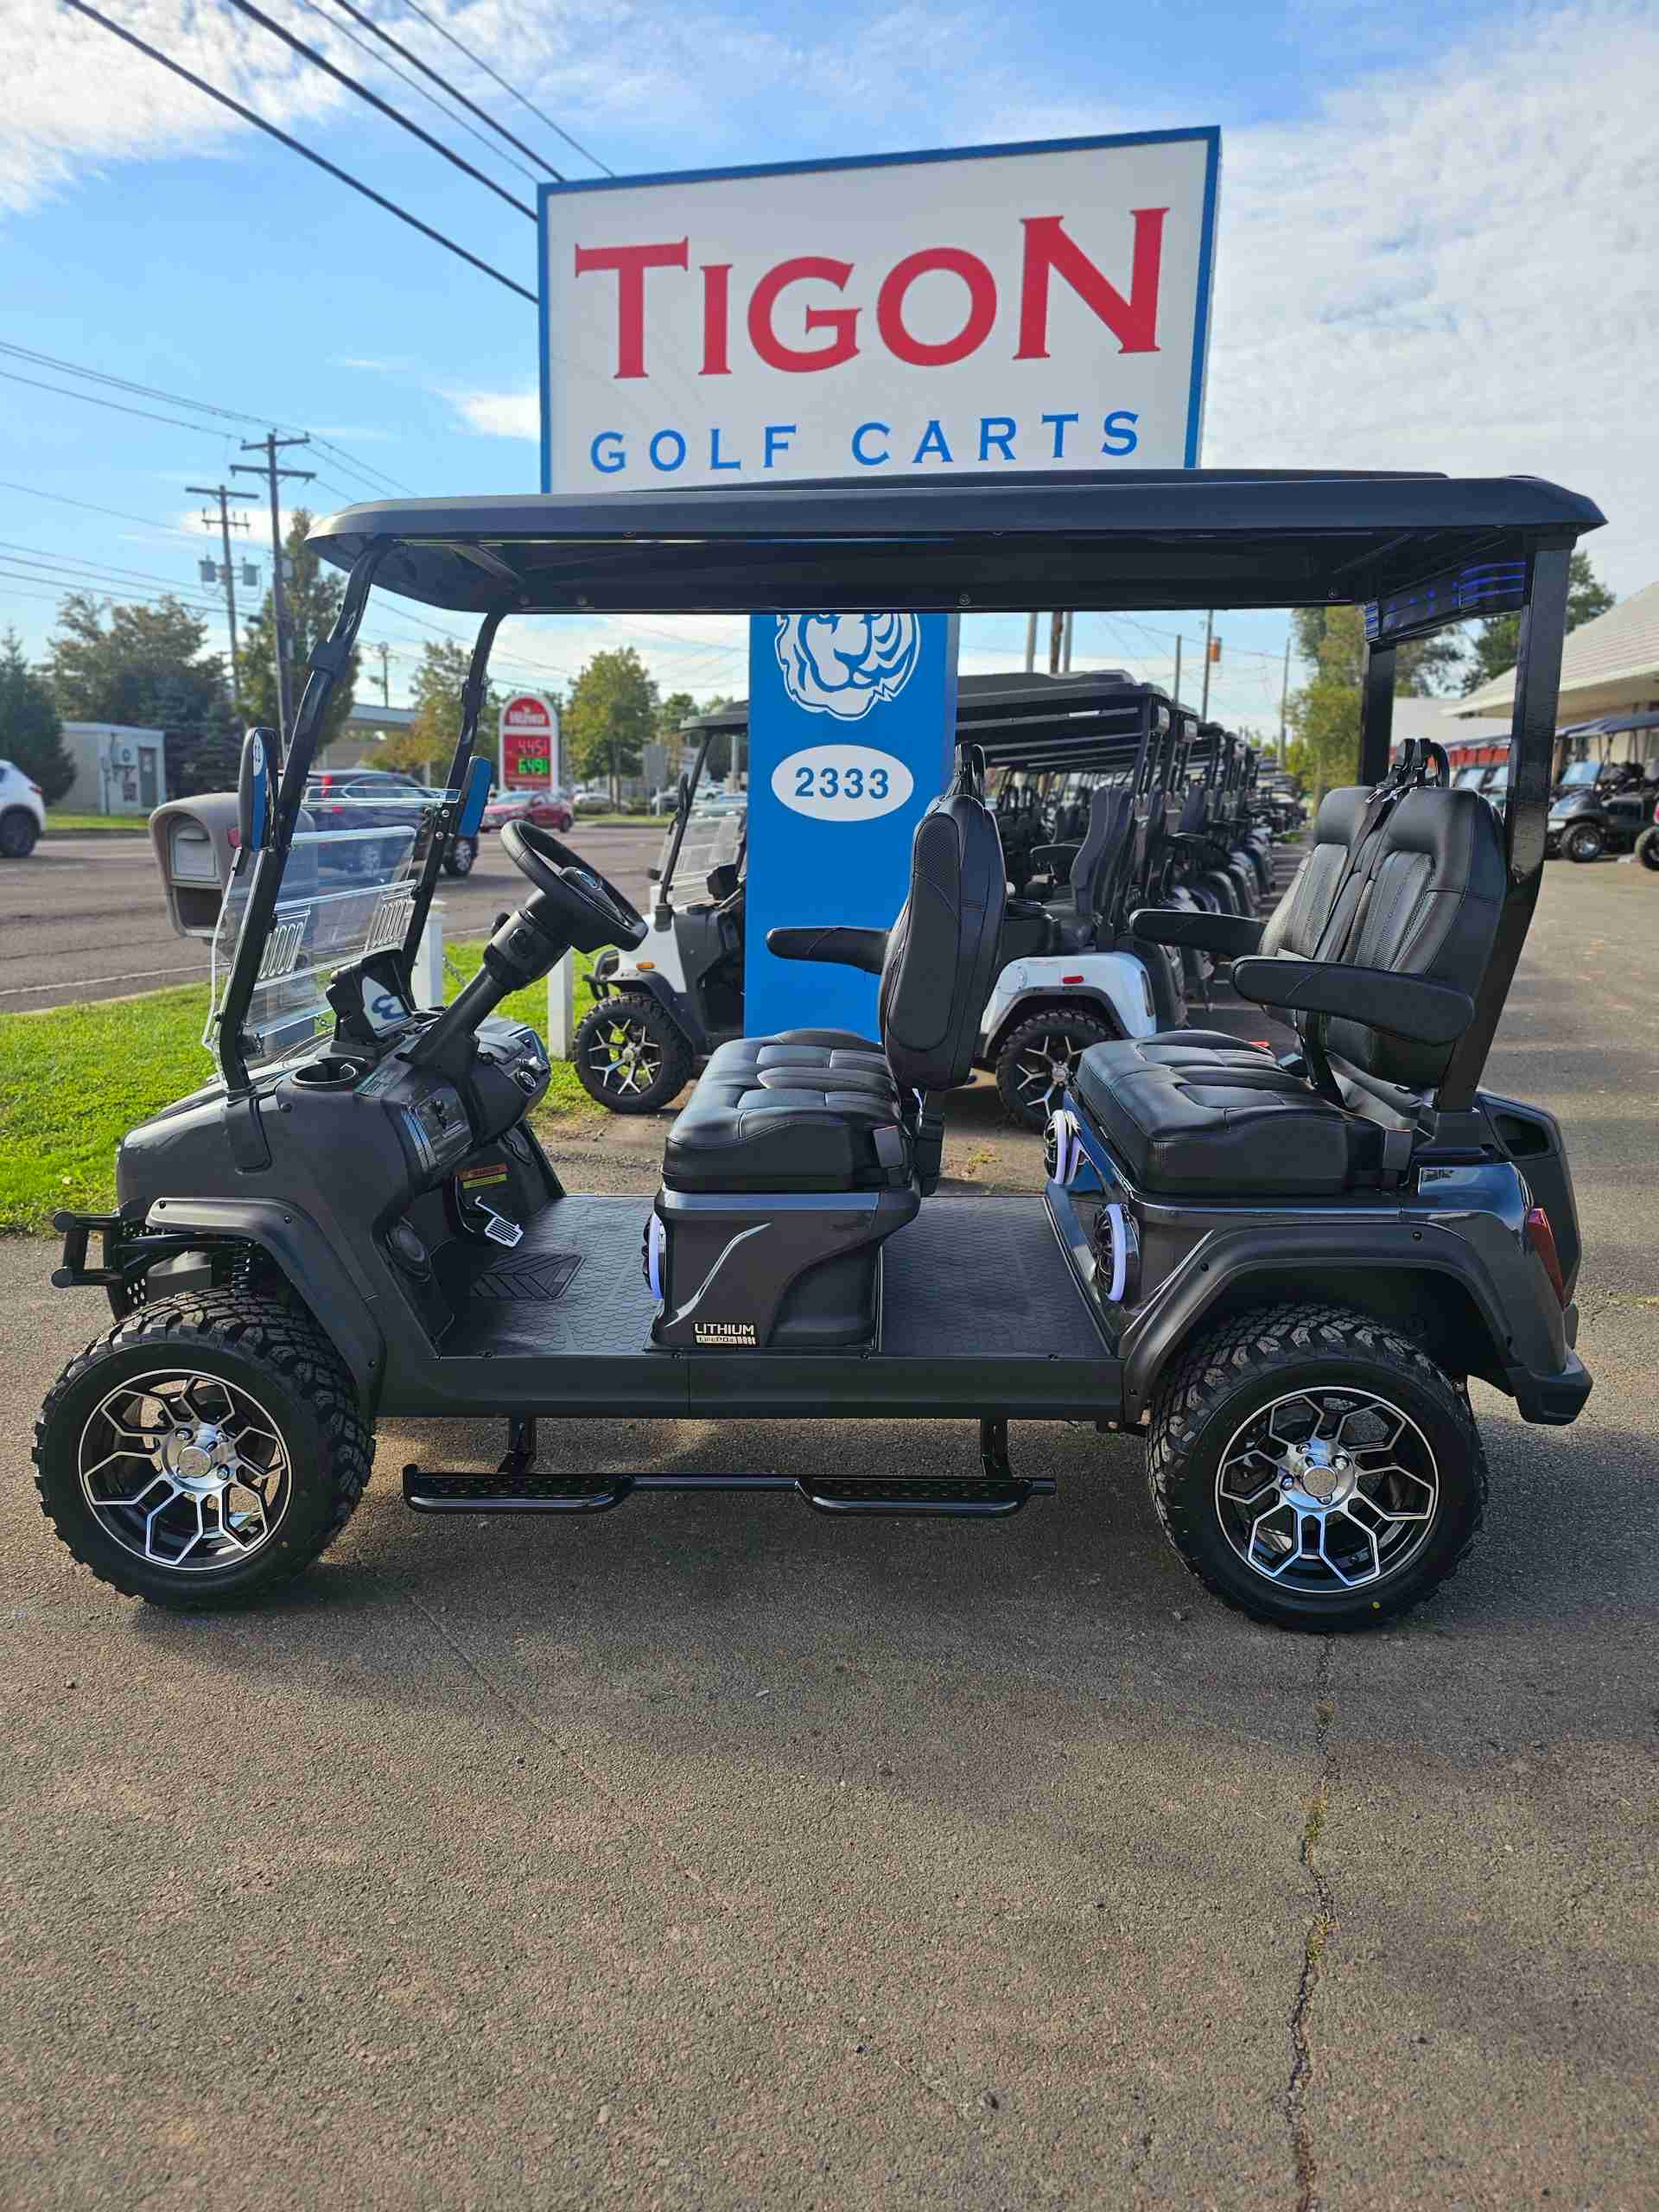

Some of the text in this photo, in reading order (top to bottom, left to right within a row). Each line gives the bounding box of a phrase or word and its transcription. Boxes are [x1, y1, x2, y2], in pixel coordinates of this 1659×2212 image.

[575, 207, 1170, 378] TIGON
[590, 410, 1139, 474] GOLF CARTS
[795, 766, 888, 799] 2333
[694, 1323, 754, 1336] LITHIUM
